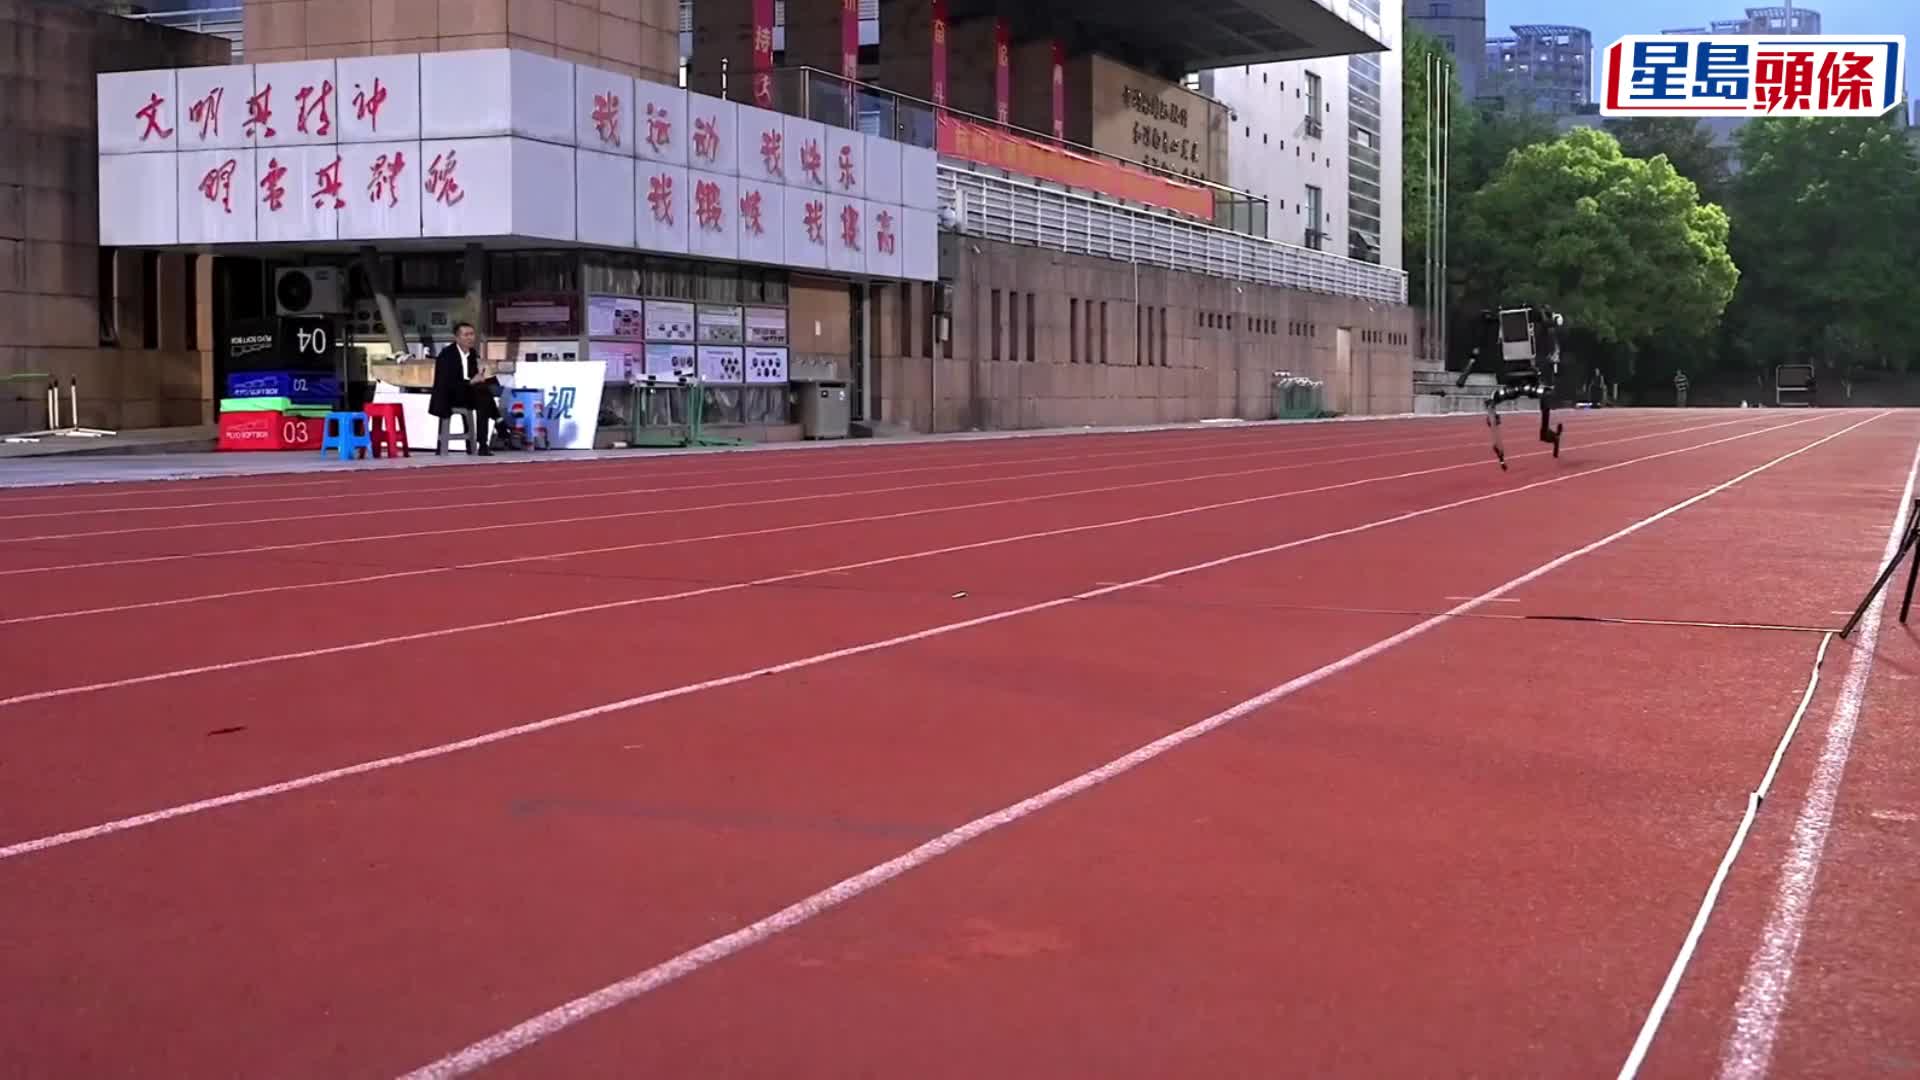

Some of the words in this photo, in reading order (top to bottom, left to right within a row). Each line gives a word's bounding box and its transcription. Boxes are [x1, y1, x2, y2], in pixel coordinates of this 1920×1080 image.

[136, 77, 387, 142] 文明其精神
[592, 91, 719, 162] 我运动
[759, 128, 856, 191] 我快乐
[803, 198, 896, 256] 我提高
[297, 327, 326, 354] 04
[293, 378, 309, 392] 02
[283, 421, 309, 443] 03
